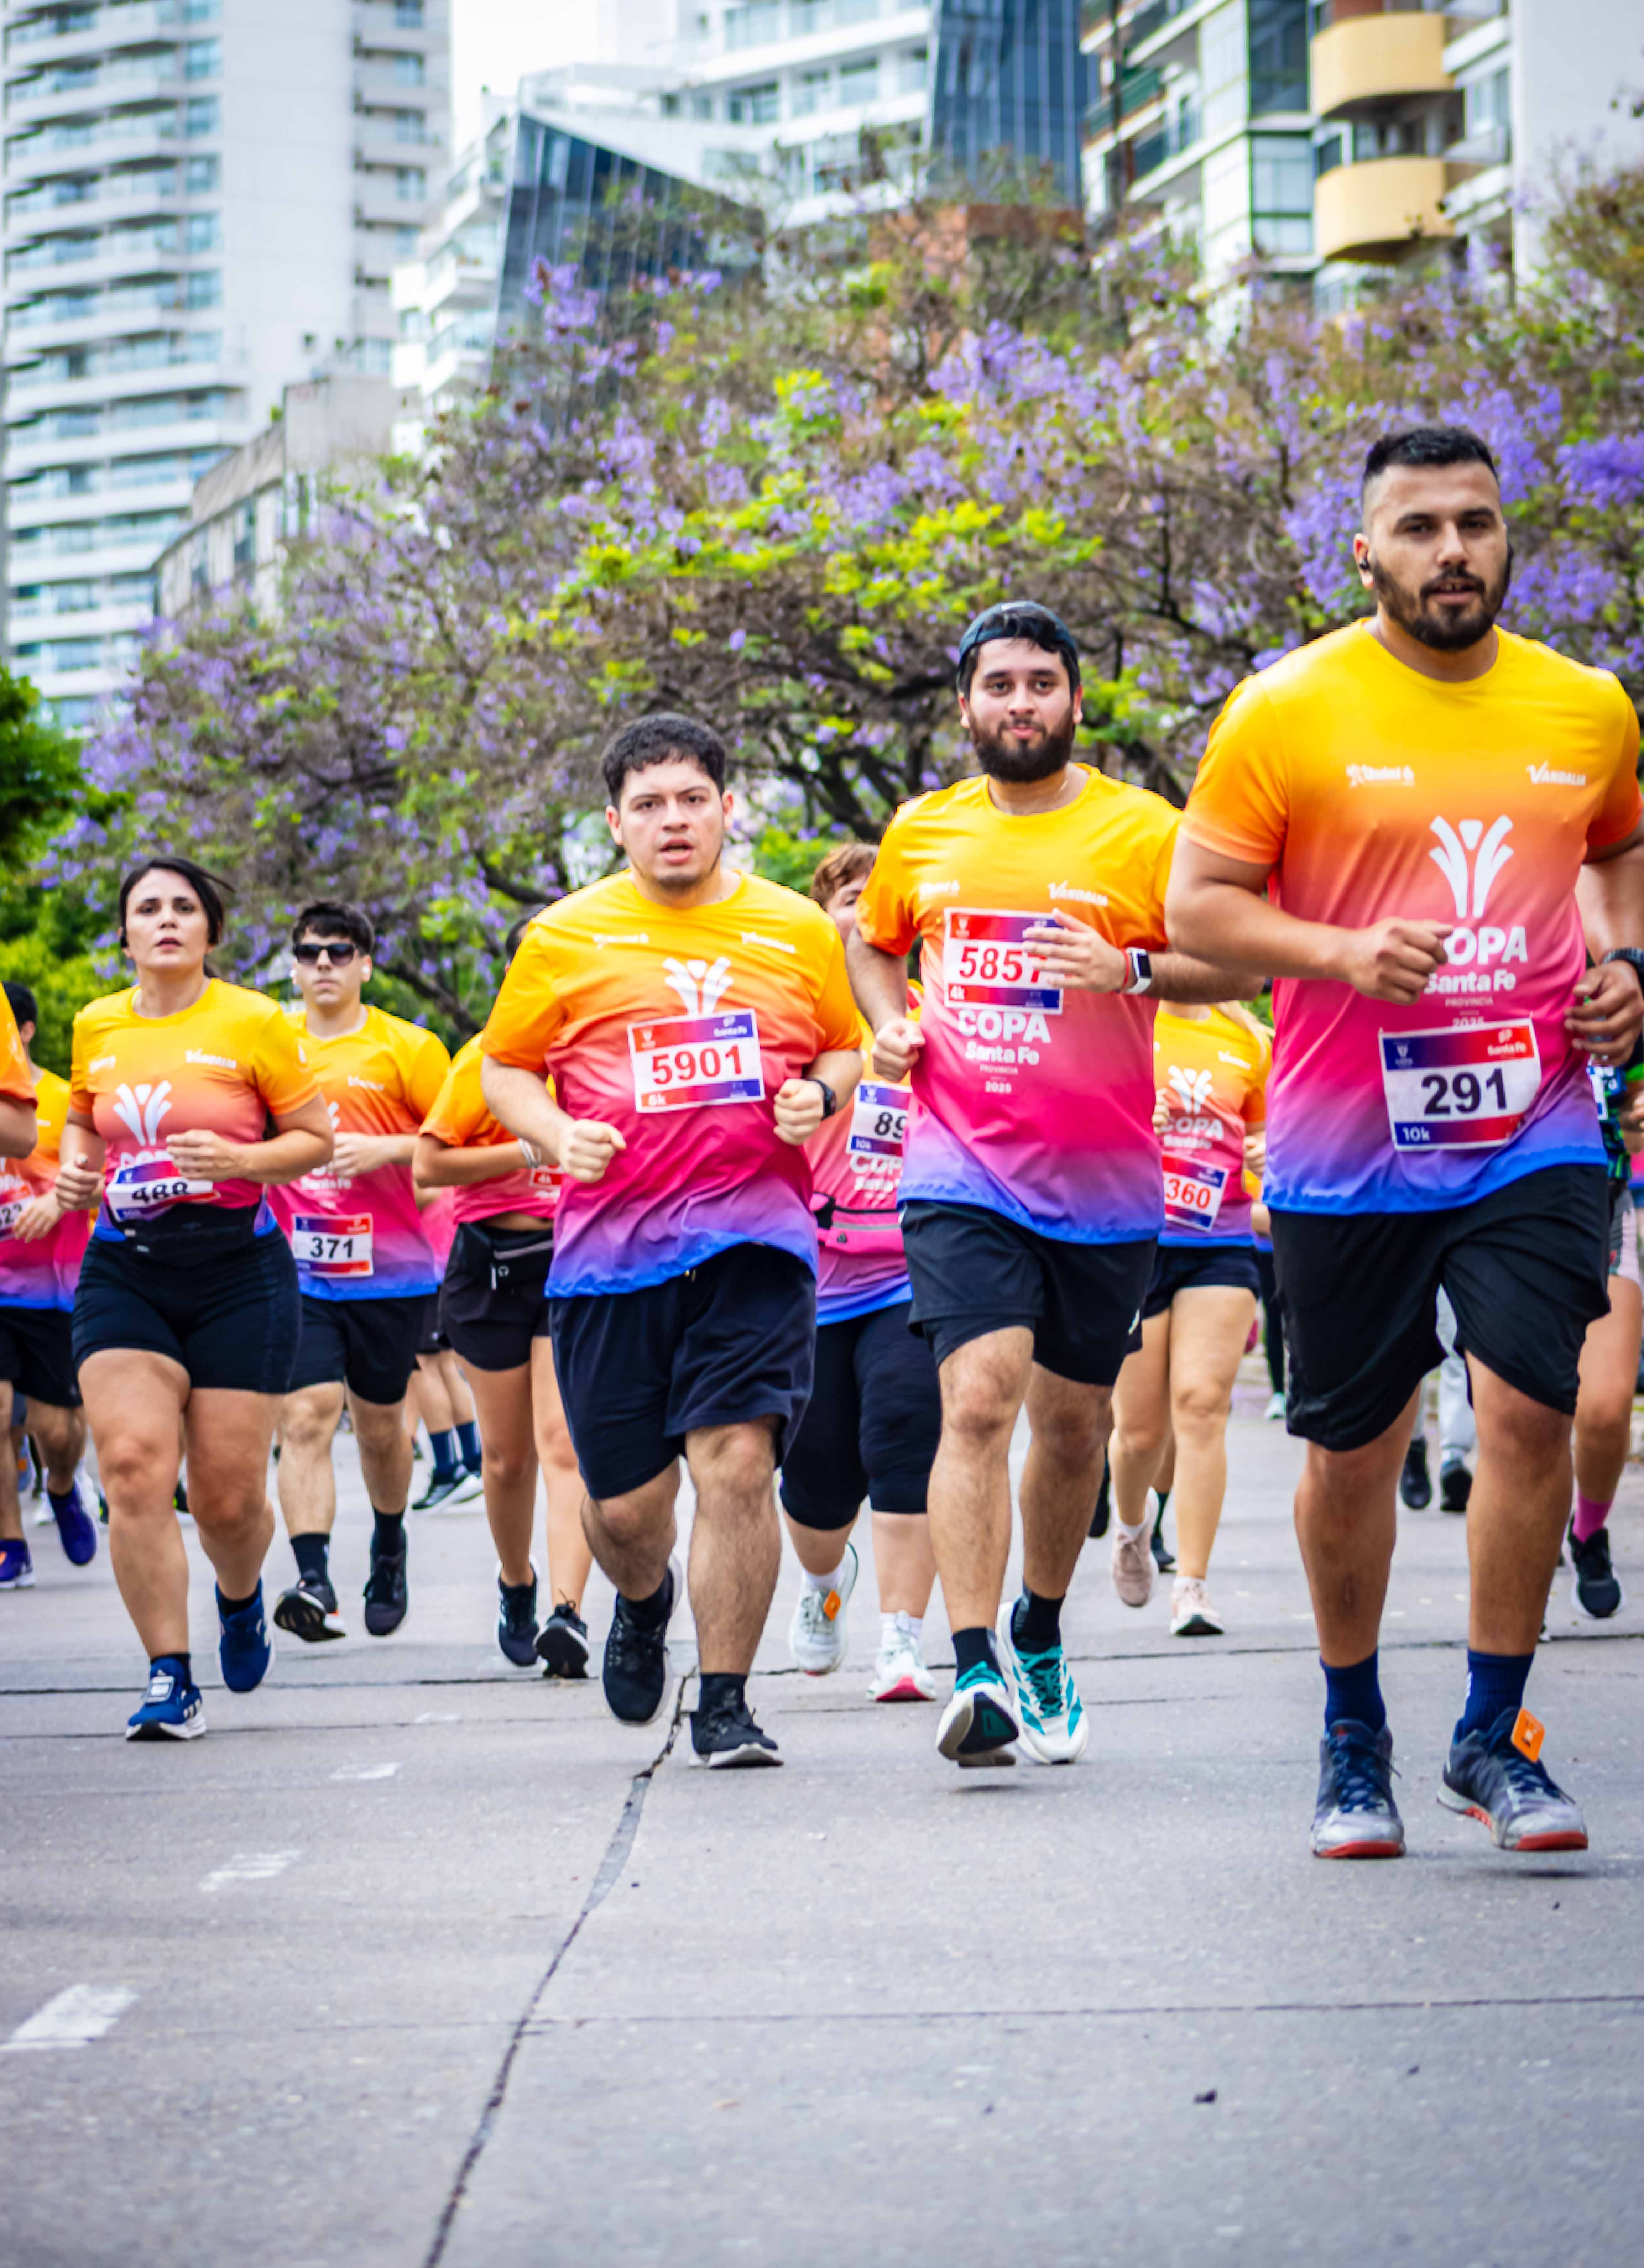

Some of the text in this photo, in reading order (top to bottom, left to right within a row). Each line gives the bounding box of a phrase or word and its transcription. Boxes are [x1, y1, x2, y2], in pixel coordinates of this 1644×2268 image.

[1443, 926, 1528, 965] OPA
[949, 985, 965, 1000] 4k
[1493, 969, 1517, 992] Fe
[958, 1010, 1052, 1044] COPA
[652, 1043, 742, 1085] 5901
[965, 1040, 1040, 1066] Santa Fe
[1421, 1068, 1507, 1115] 291
[1402, 1126, 1430, 1142] 10k
[310, 1236, 354, 1259] 371
